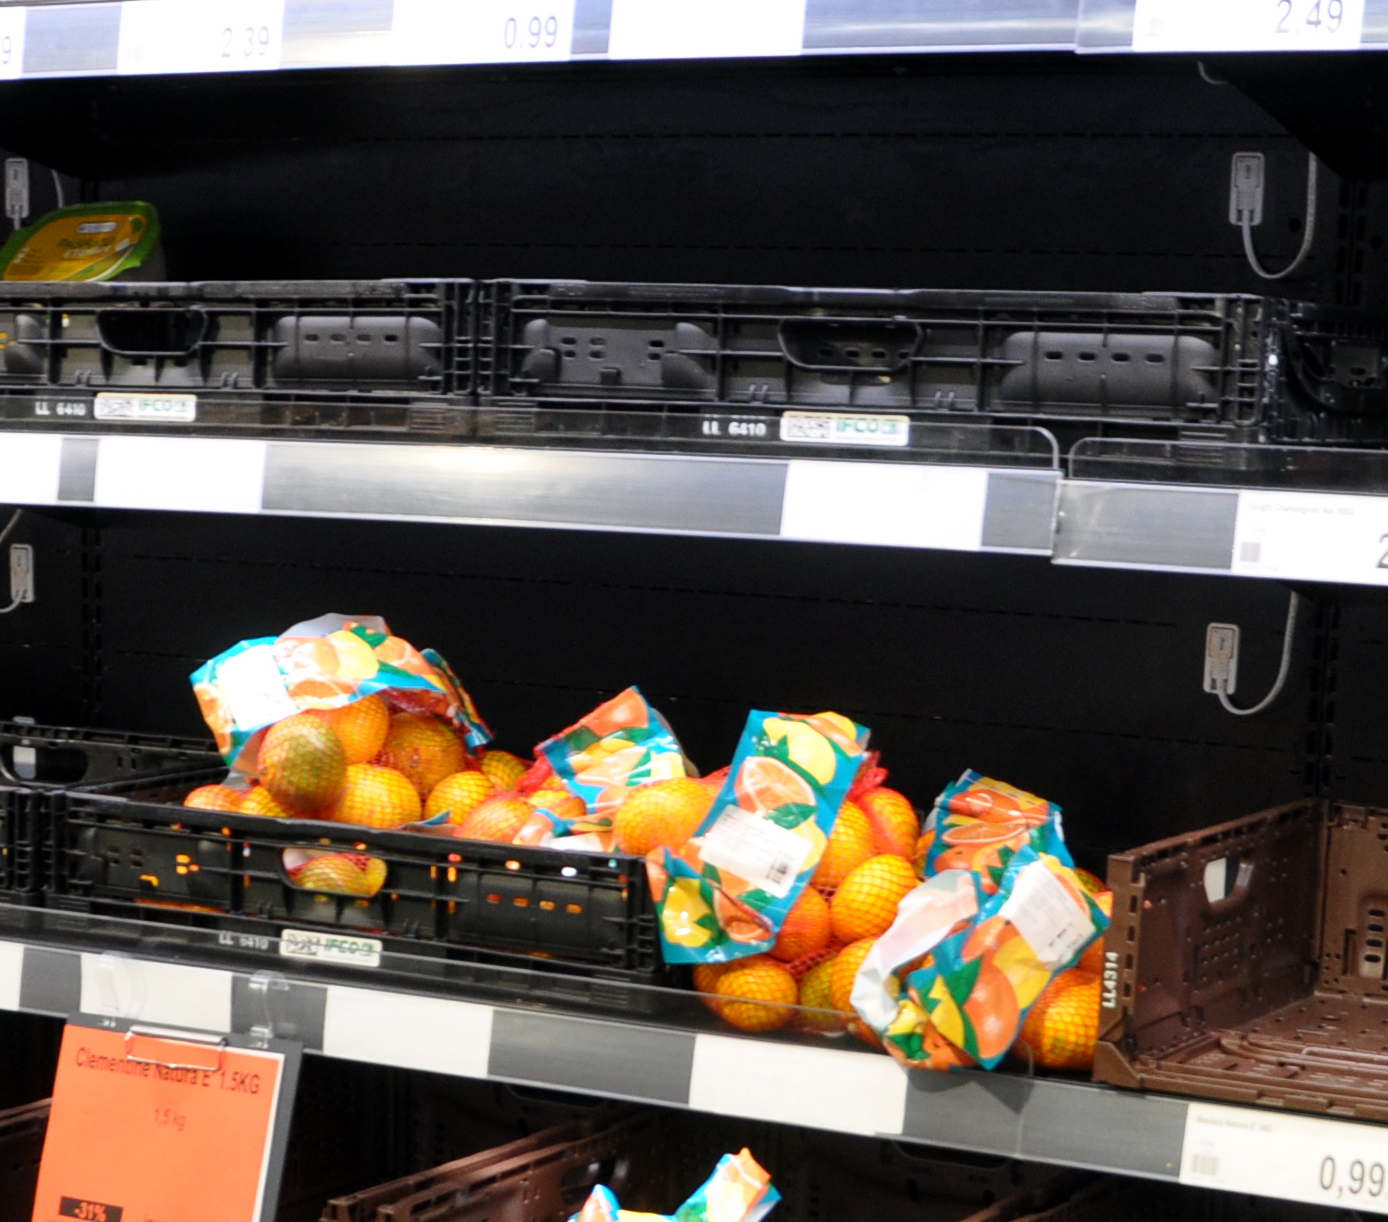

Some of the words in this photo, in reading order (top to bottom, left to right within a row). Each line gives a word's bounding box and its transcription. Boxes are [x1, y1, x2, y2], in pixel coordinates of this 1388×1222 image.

[1101, 951, 1120, 1009] LL4314
[75, 1046, 150, 1078] Clementine
[154, 1064, 198, 1086] Natura
[1319, 1154, 1386, 1200] 0,99
[73, 1201, 107, 1222] -31%
